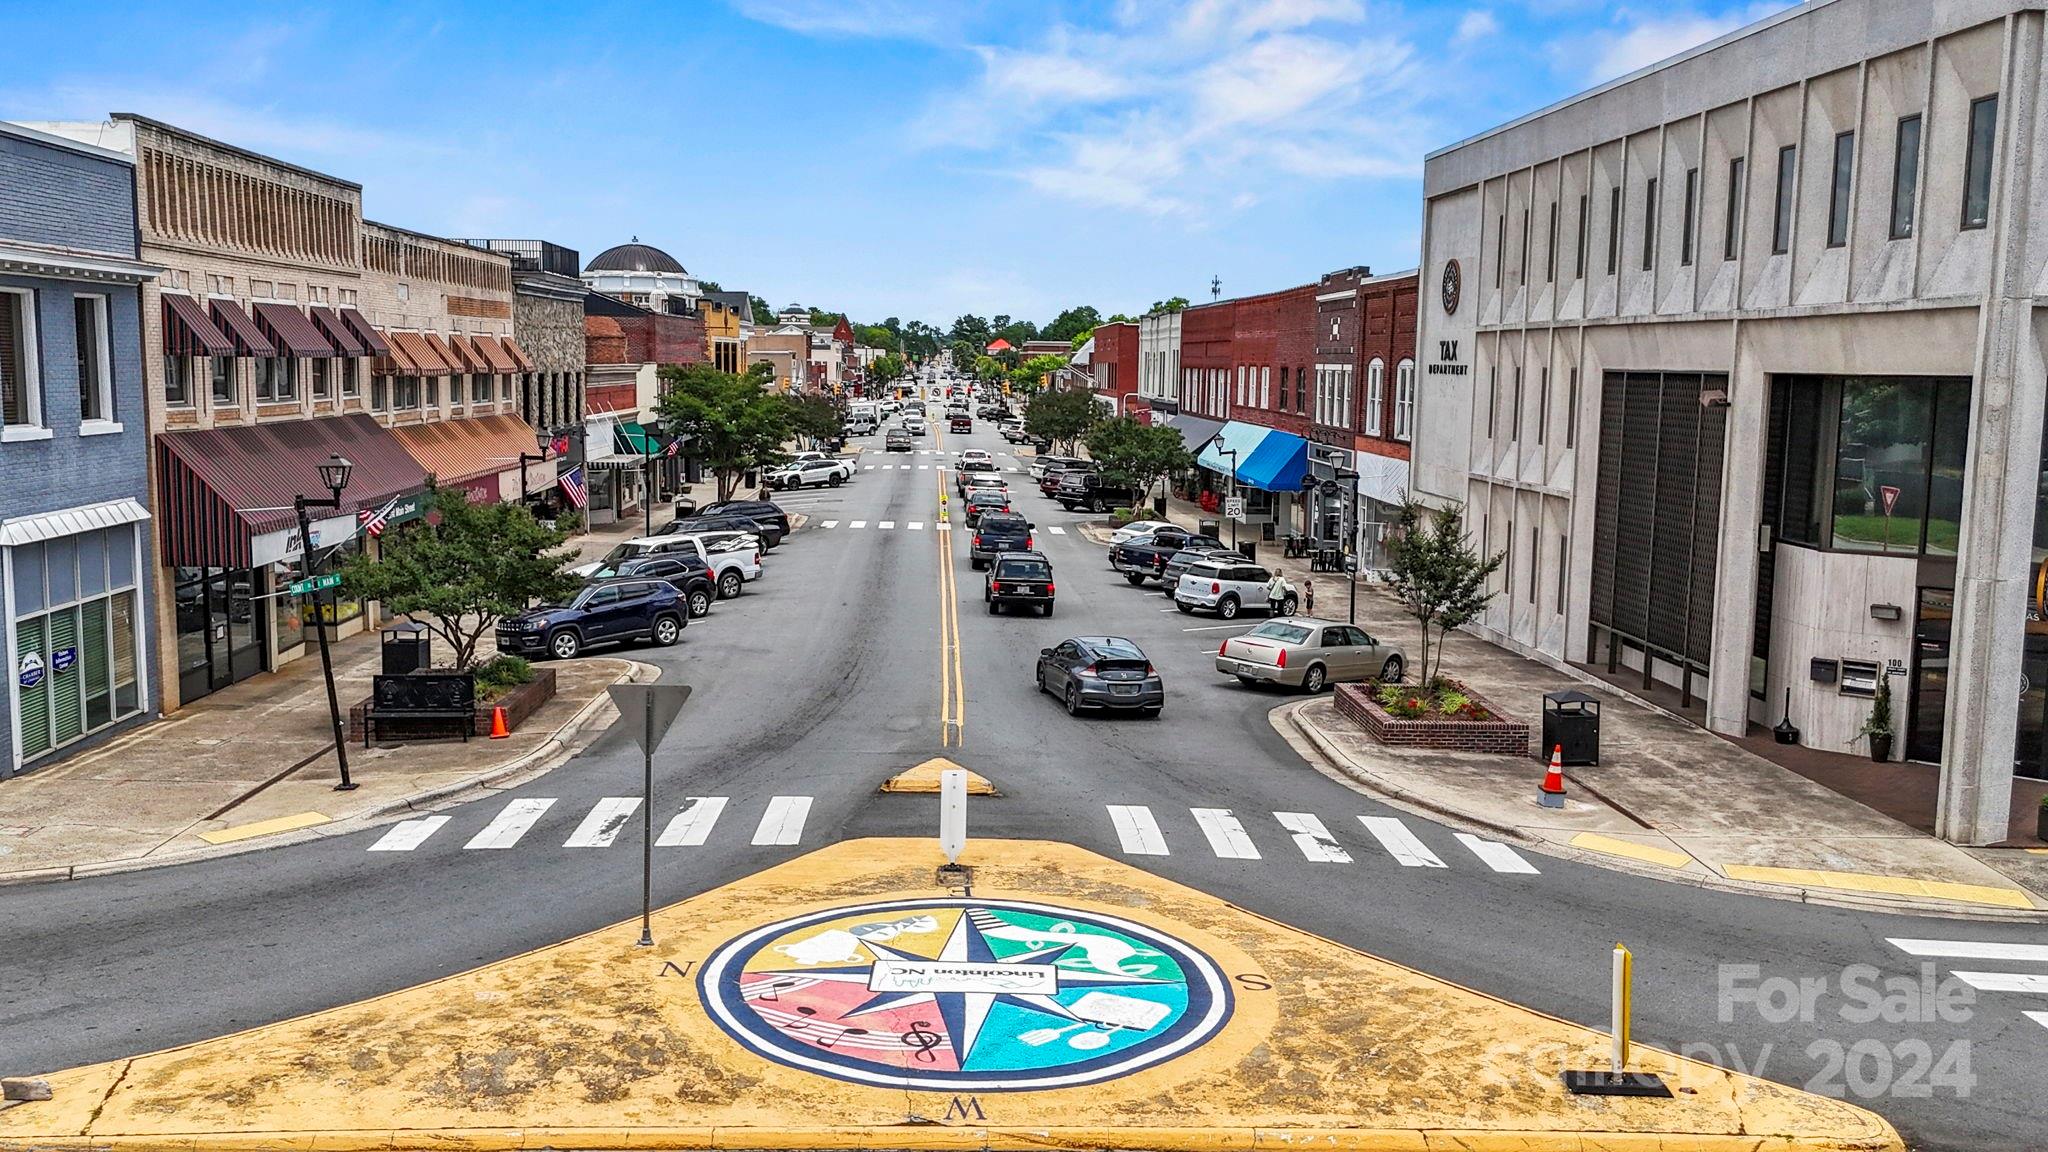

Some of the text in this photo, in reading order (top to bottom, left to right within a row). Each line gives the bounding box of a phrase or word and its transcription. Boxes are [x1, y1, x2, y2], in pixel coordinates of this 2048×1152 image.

[1440, 340, 1458, 361] TAX
[1428, 364, 1469, 376] DEPARTMENT
[1227, 507, 1241, 516] 20
[322, 576, 335, 587] MAIN
[1887, 659, 1903, 668] 100
[655, 961, 697, 977] N
[890, 967, 1046, 980] Lincolnton NC
[1235, 973, 1272, 991] S
